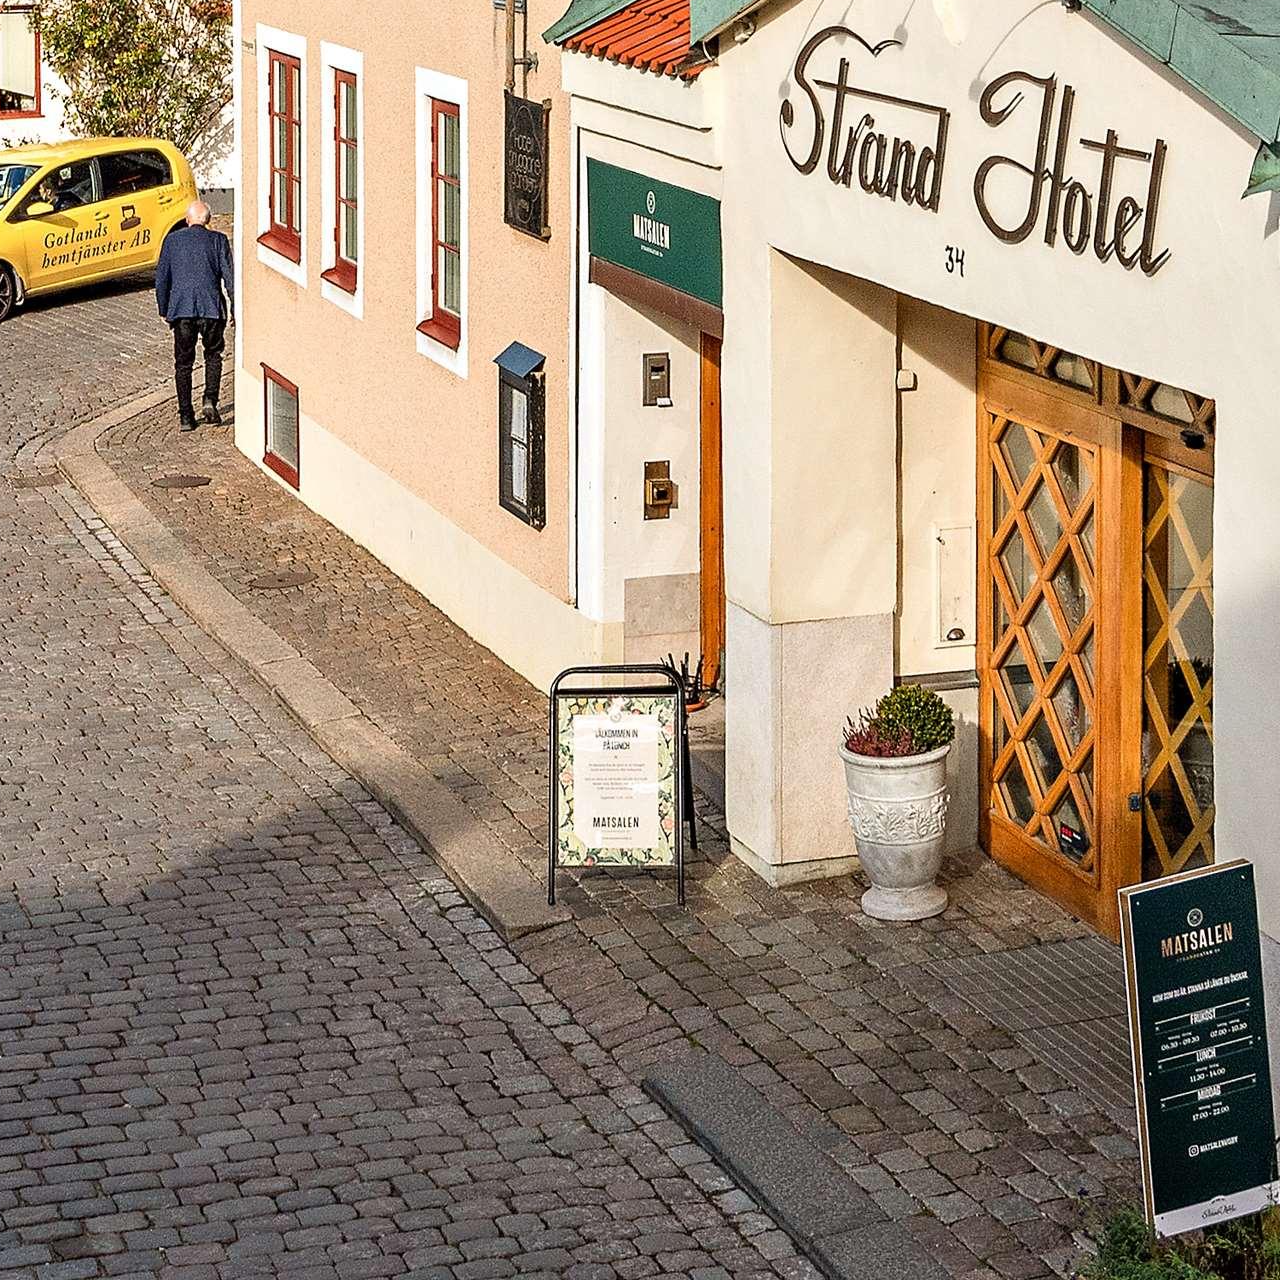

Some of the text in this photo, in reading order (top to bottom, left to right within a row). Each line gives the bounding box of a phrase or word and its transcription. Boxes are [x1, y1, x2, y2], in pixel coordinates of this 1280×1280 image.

[780, 25, 1171, 277] Strand Hotel
[42, 229, 151, 269] hemtjänster AB
[44, 223, 108, 249] Gotlands
[633, 213, 670, 250] MATSALEN
[945, 245, 965, 277] 34
[593, 817, 639, 828] MATSALEN
[1161, 921, 1233, 958] MATSALEN
